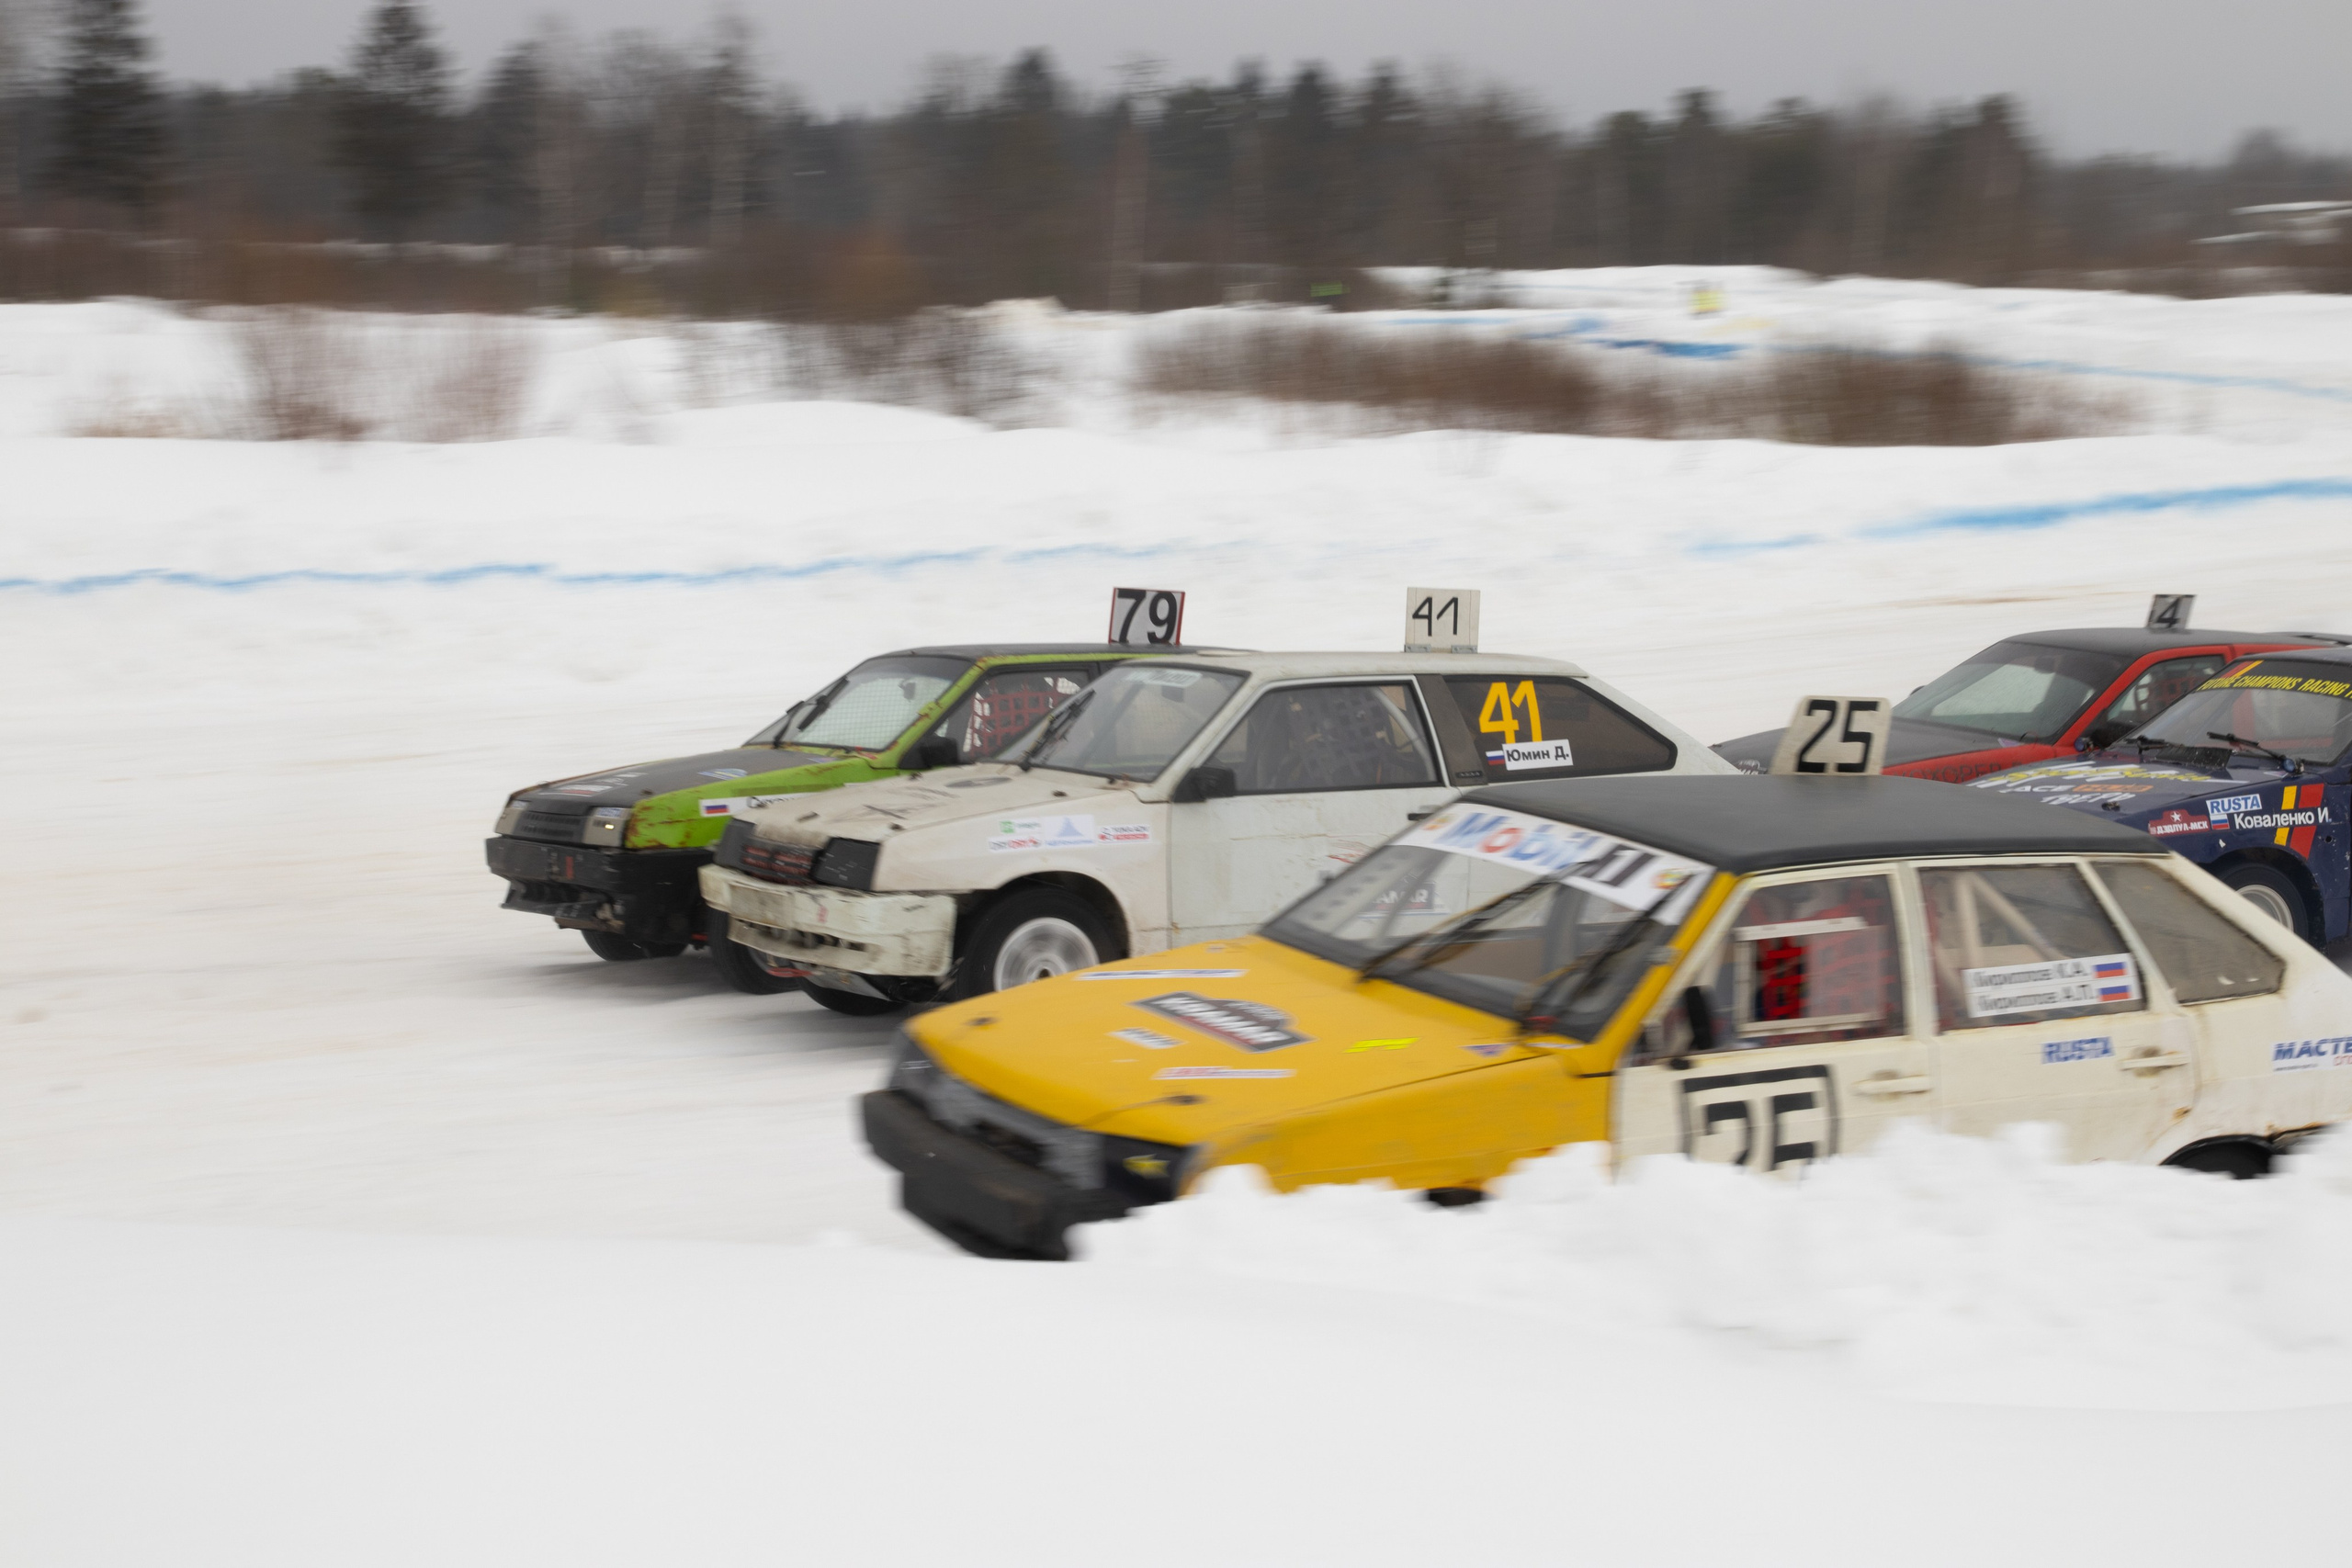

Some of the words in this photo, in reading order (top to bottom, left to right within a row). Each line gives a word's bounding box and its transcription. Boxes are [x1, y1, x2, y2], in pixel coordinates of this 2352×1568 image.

[1117, 588, 1178, 644] 79
[1412, 596, 1458, 637] 41
[2155, 596, 2181, 628] 4
[2232, 674, 2302, 690] CHAMPIONS
[2298, 678, 2351, 696] RACING
[1478, 680, 1543, 744] 41
[1795, 699, 1881, 773] 25
[1507, 749, 1551, 761] Юмин
[1555, 745, 1570, 761] Д.
[2210, 795, 2261, 814] RUSTA
[2233, 811, 2315, 829] Коваленко
[2317, 807, 2333, 824] И.
[2043, 1037, 2112, 1064] RUSTA
